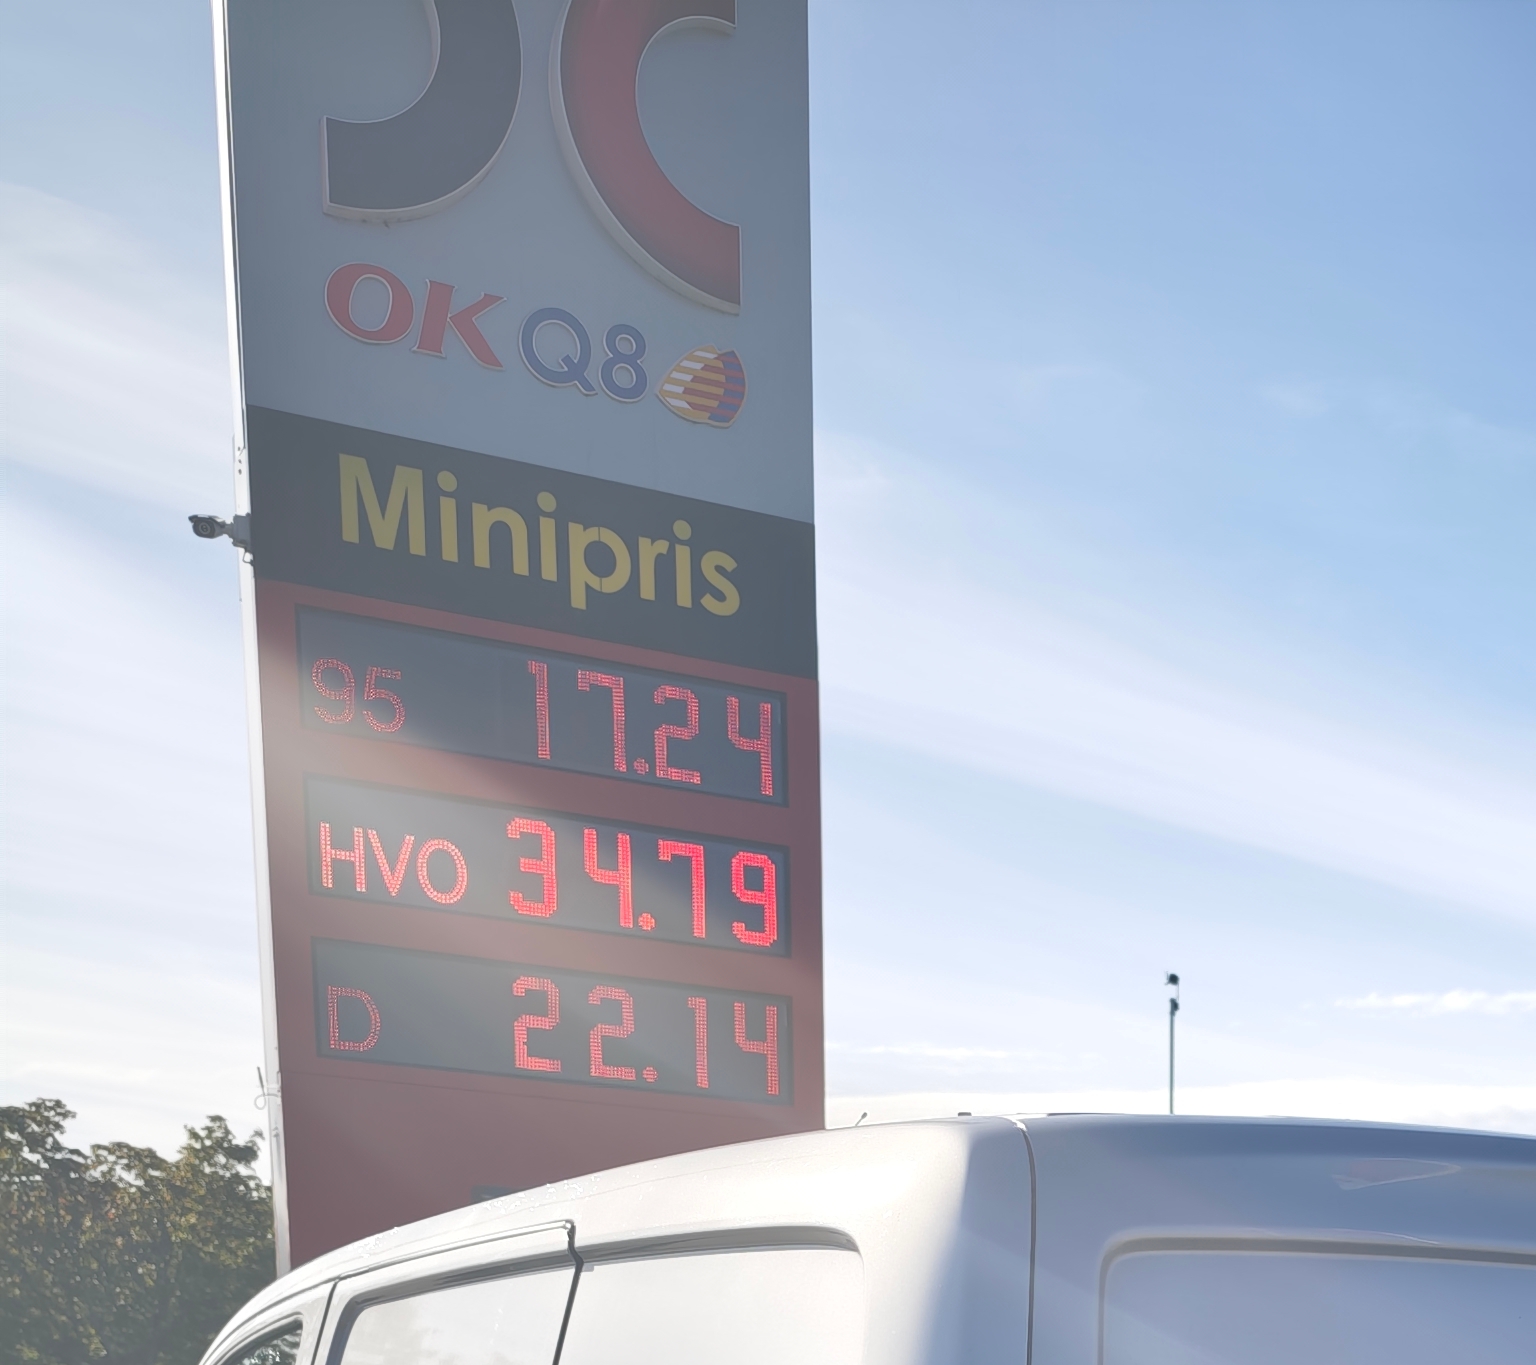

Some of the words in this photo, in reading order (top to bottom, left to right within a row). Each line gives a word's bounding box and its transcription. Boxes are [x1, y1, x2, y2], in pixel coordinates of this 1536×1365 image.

[338, 453, 741, 617] Minipris
[311, 658, 406, 733] 95
[528, 660, 774, 797] 17.24
[318, 821, 468, 905] HVO
[507, 816, 778, 947] 34.79
[327, 985, 381, 1052] D
[511, 975, 779, 1095] 22.14
